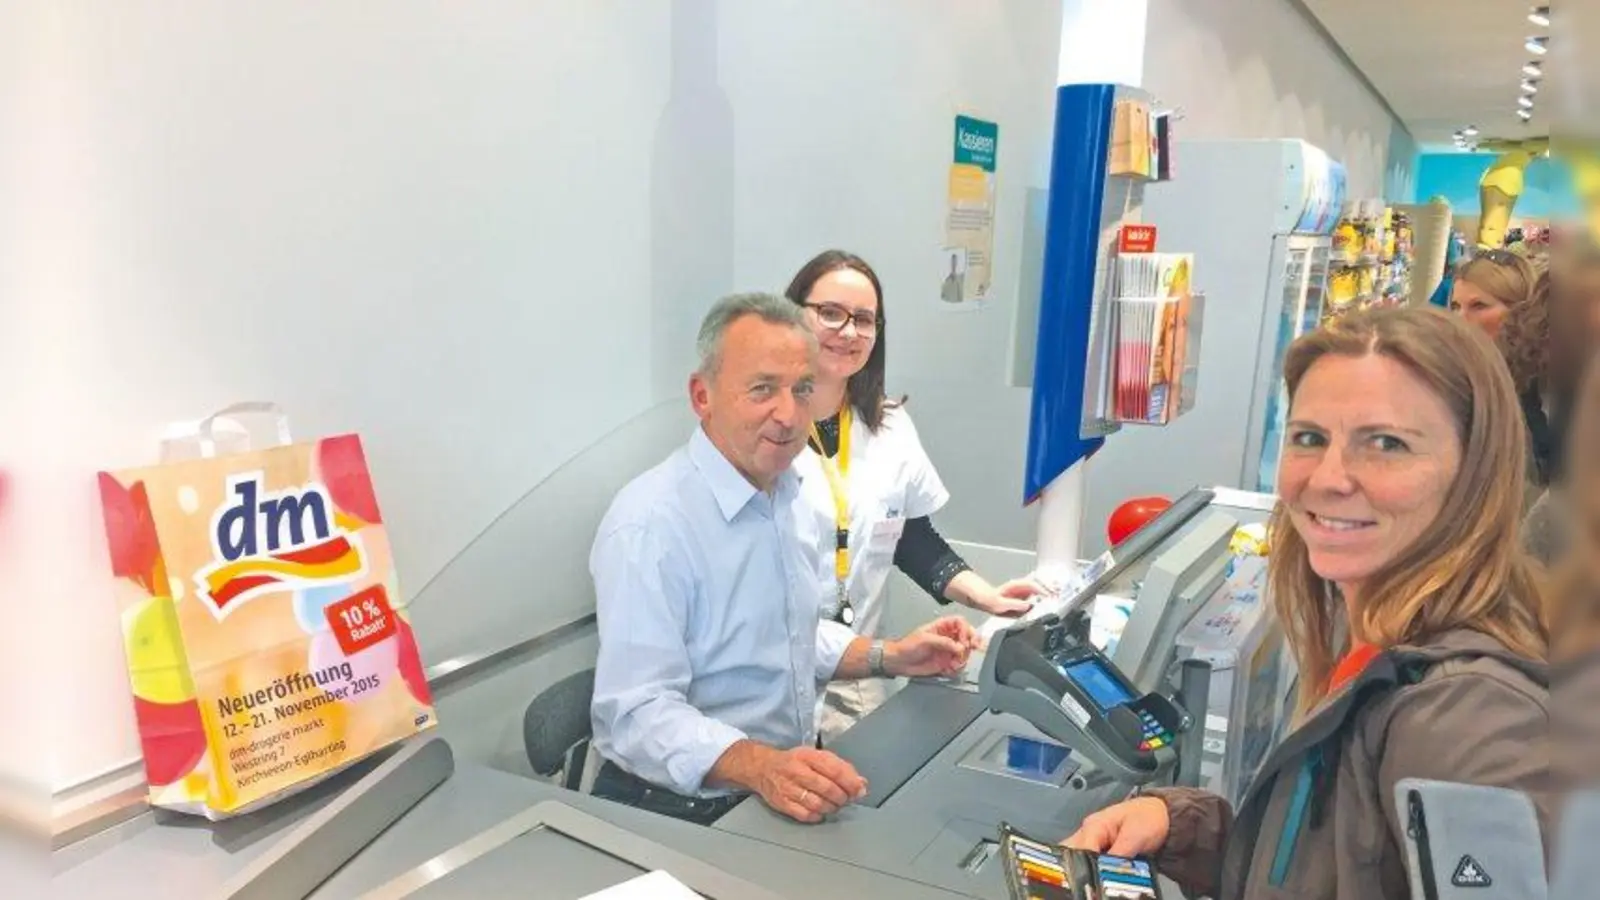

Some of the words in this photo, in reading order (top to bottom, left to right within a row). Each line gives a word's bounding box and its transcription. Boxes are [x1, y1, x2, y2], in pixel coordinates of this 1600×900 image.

[217, 480, 330, 561] dm
[340, 605, 363, 629] 10
[362, 598, 381, 620] %
[217, 661, 353, 718] Neueröffnung
[274, 686, 349, 721] November
[351, 674, 380, 695] 2015
[229, 730, 291, 760] dm-drogerie
[292, 718, 325, 737] markt
[231, 751, 278, 774] Westring
